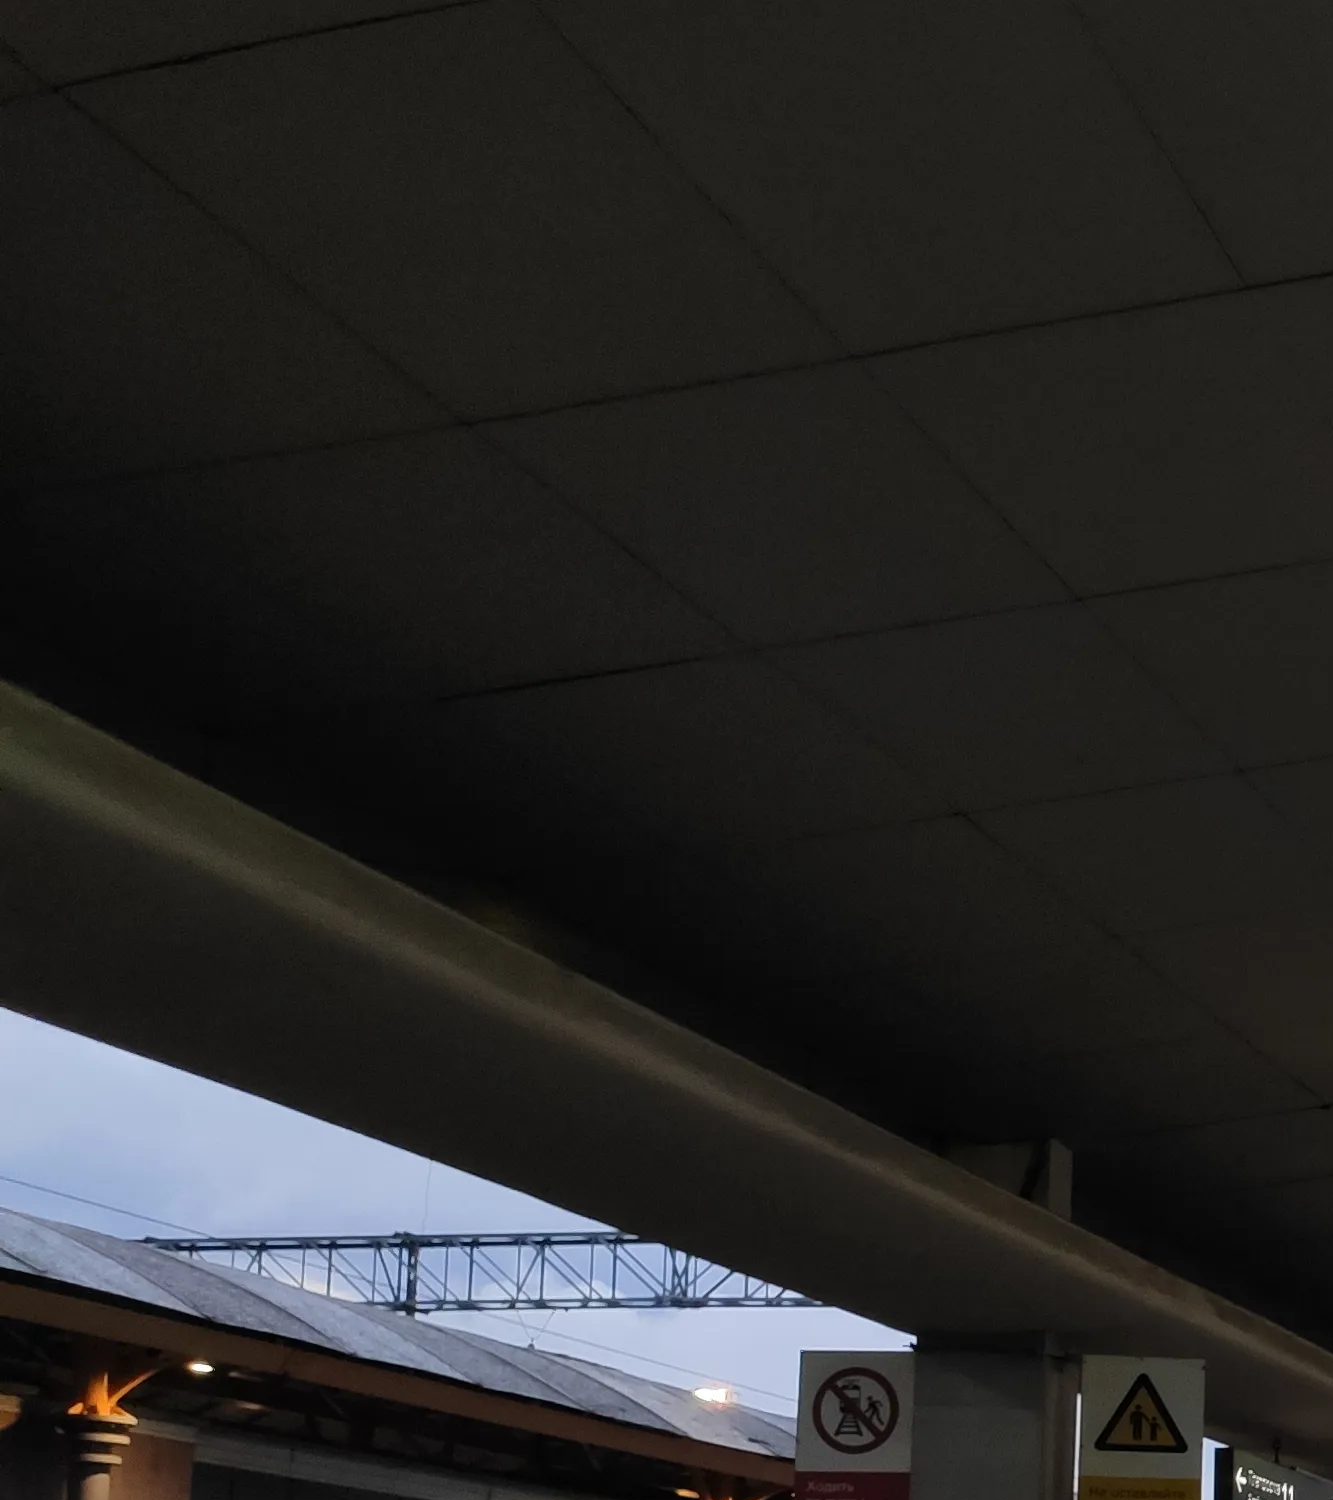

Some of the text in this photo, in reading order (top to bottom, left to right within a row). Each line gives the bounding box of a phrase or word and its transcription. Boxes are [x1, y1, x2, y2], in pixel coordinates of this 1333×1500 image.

[804, 1479, 855, 1494] Ходить
[1088, 1486, 1187, 1500] Не оставляйте
